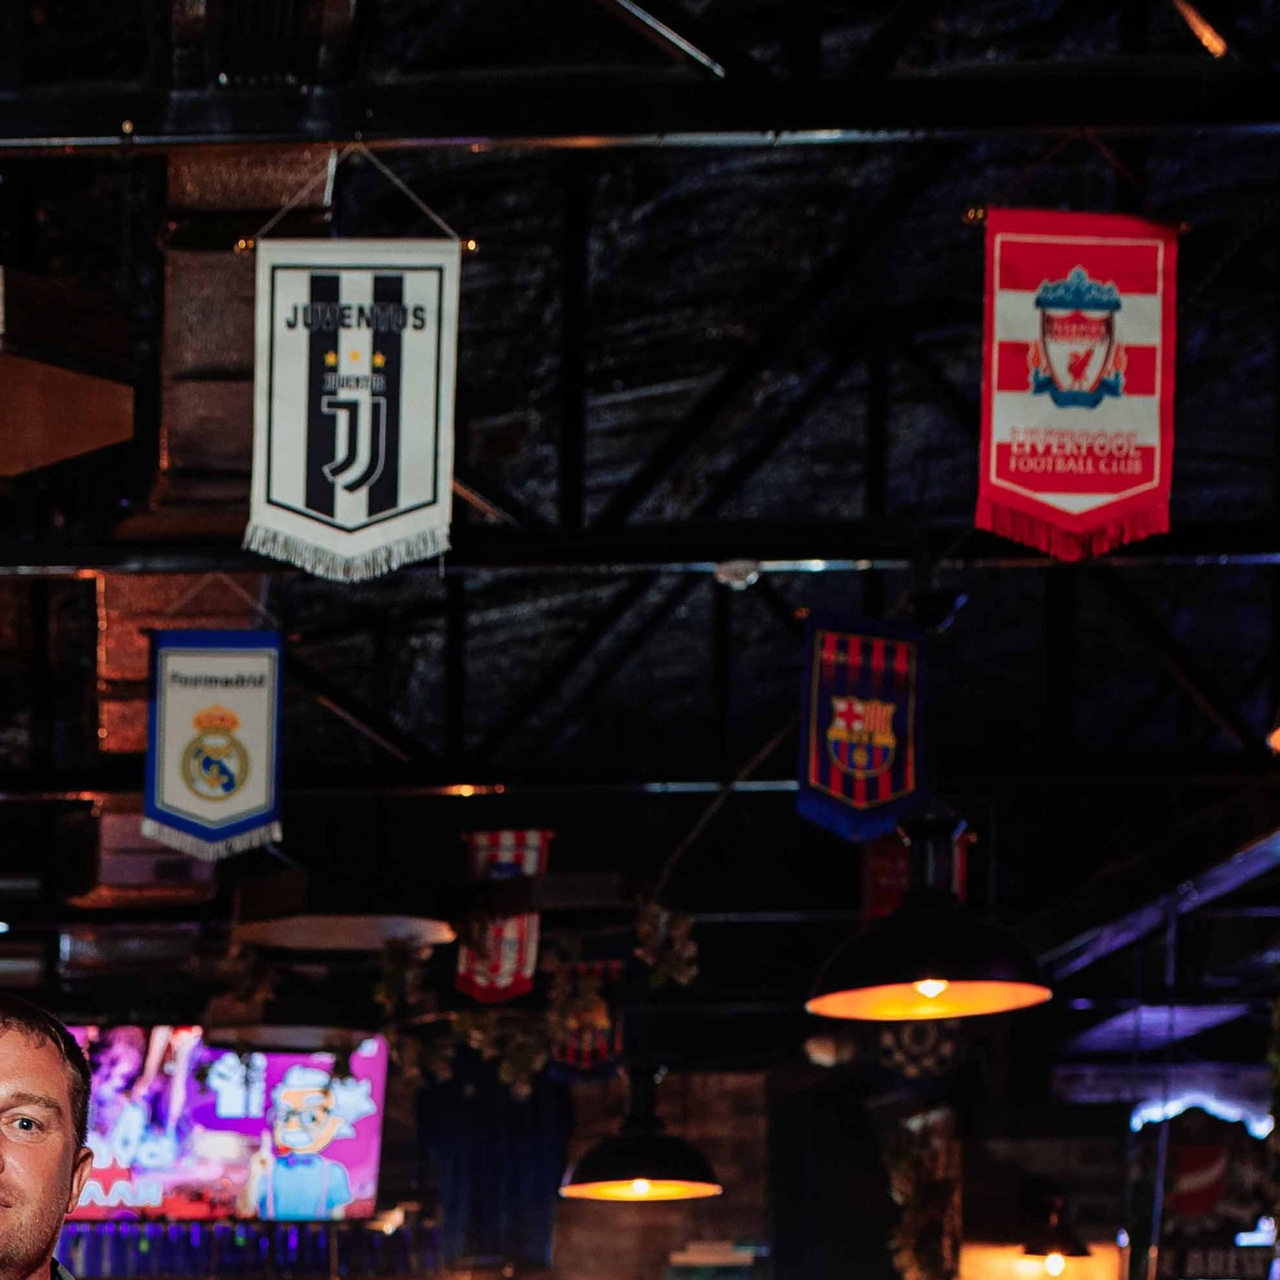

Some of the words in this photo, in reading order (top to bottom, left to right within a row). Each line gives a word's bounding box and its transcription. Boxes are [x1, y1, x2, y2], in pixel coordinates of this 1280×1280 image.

[285, 302, 427, 334] JUVENTUS
[322, 372, 387, 393] JUVENTUS
[1009, 427, 1143, 459] LIVERPOOL
[1008, 456, 1094, 474] FOOTBALL
[1098, 458, 1143, 475] CLUB
